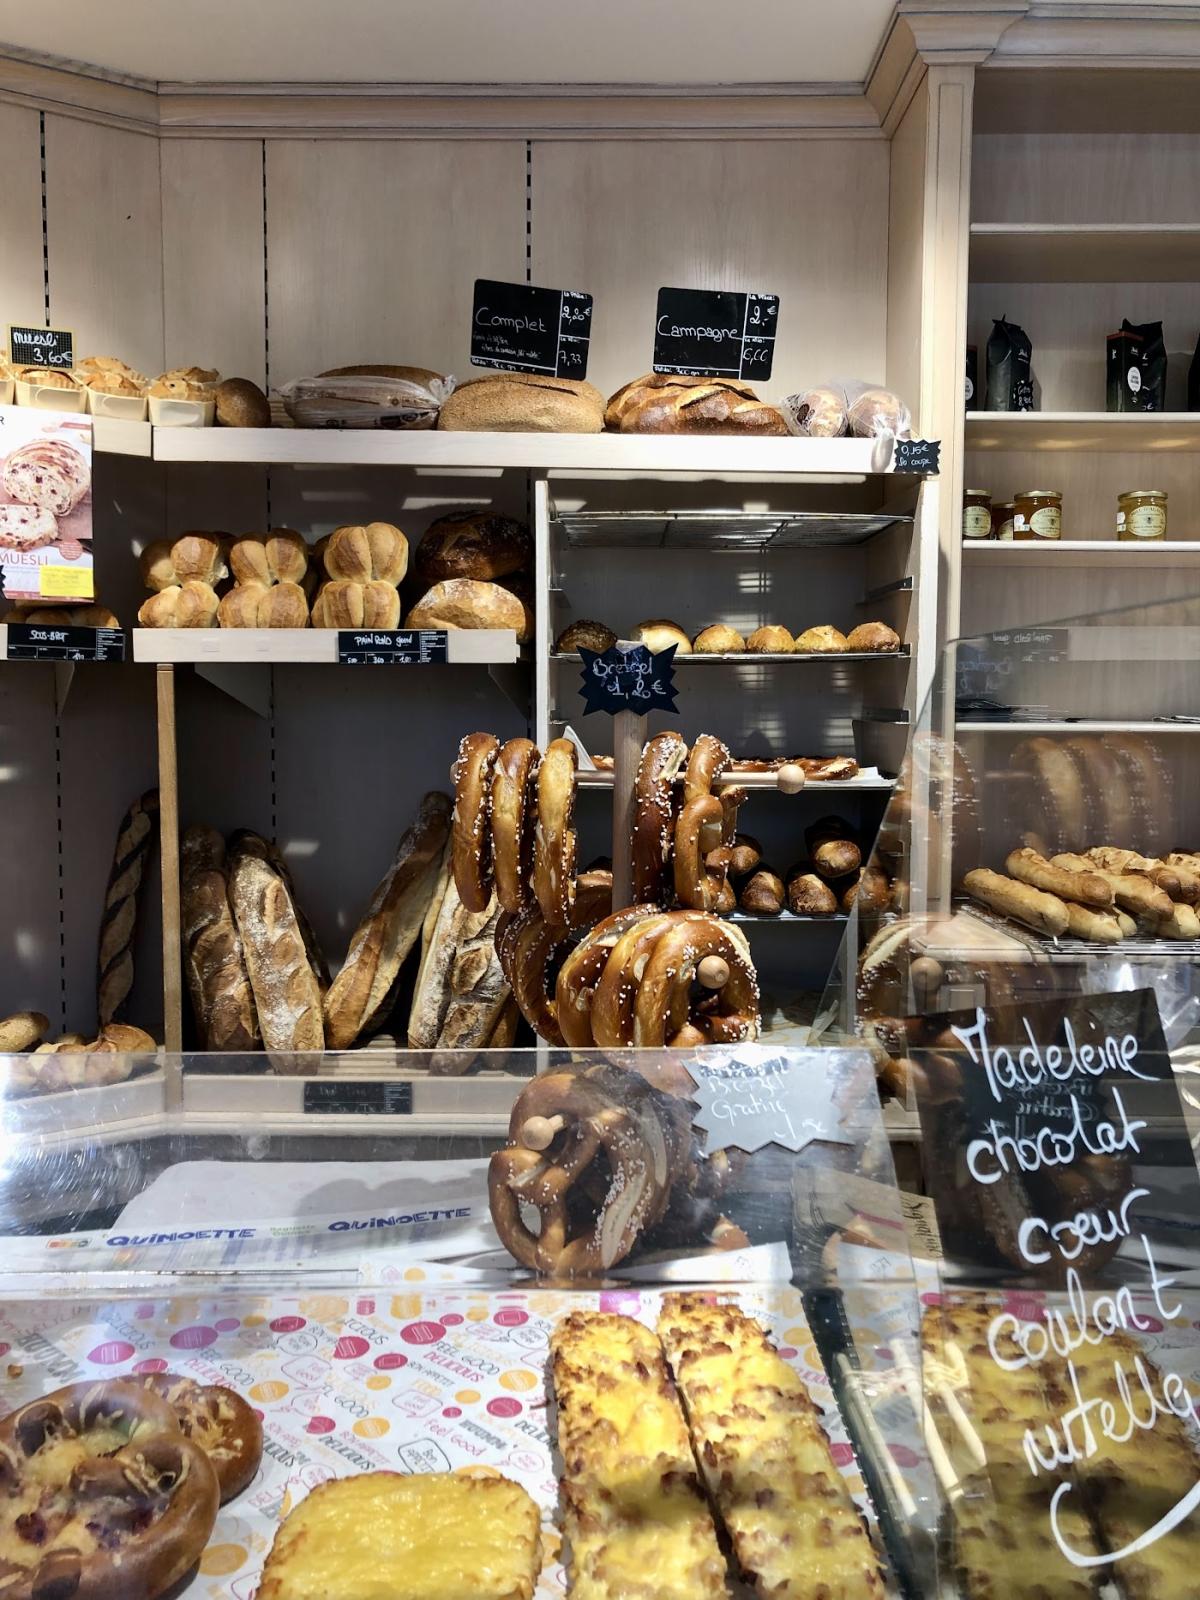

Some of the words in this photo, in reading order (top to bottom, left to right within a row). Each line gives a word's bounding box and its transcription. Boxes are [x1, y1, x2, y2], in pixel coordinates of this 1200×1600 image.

[475, 306, 547, 333] Complet
[657, 314, 743, 342] Campagne
[13, 332, 58, 347] muesli
[559, 350, 582, 367] 7,33
[0, 553, 48, 566] MUESLI
[592, 655, 653, 681] Bretzel
[951, 1007, 1161, 1103] Madeleine
[966, 1086, 1148, 1184] chocolat
[988, 1233, 1182, 1370] coulant
[461, 1356, 500, 1375] GOOD
[1023, 1355, 1200, 1477] nutella
